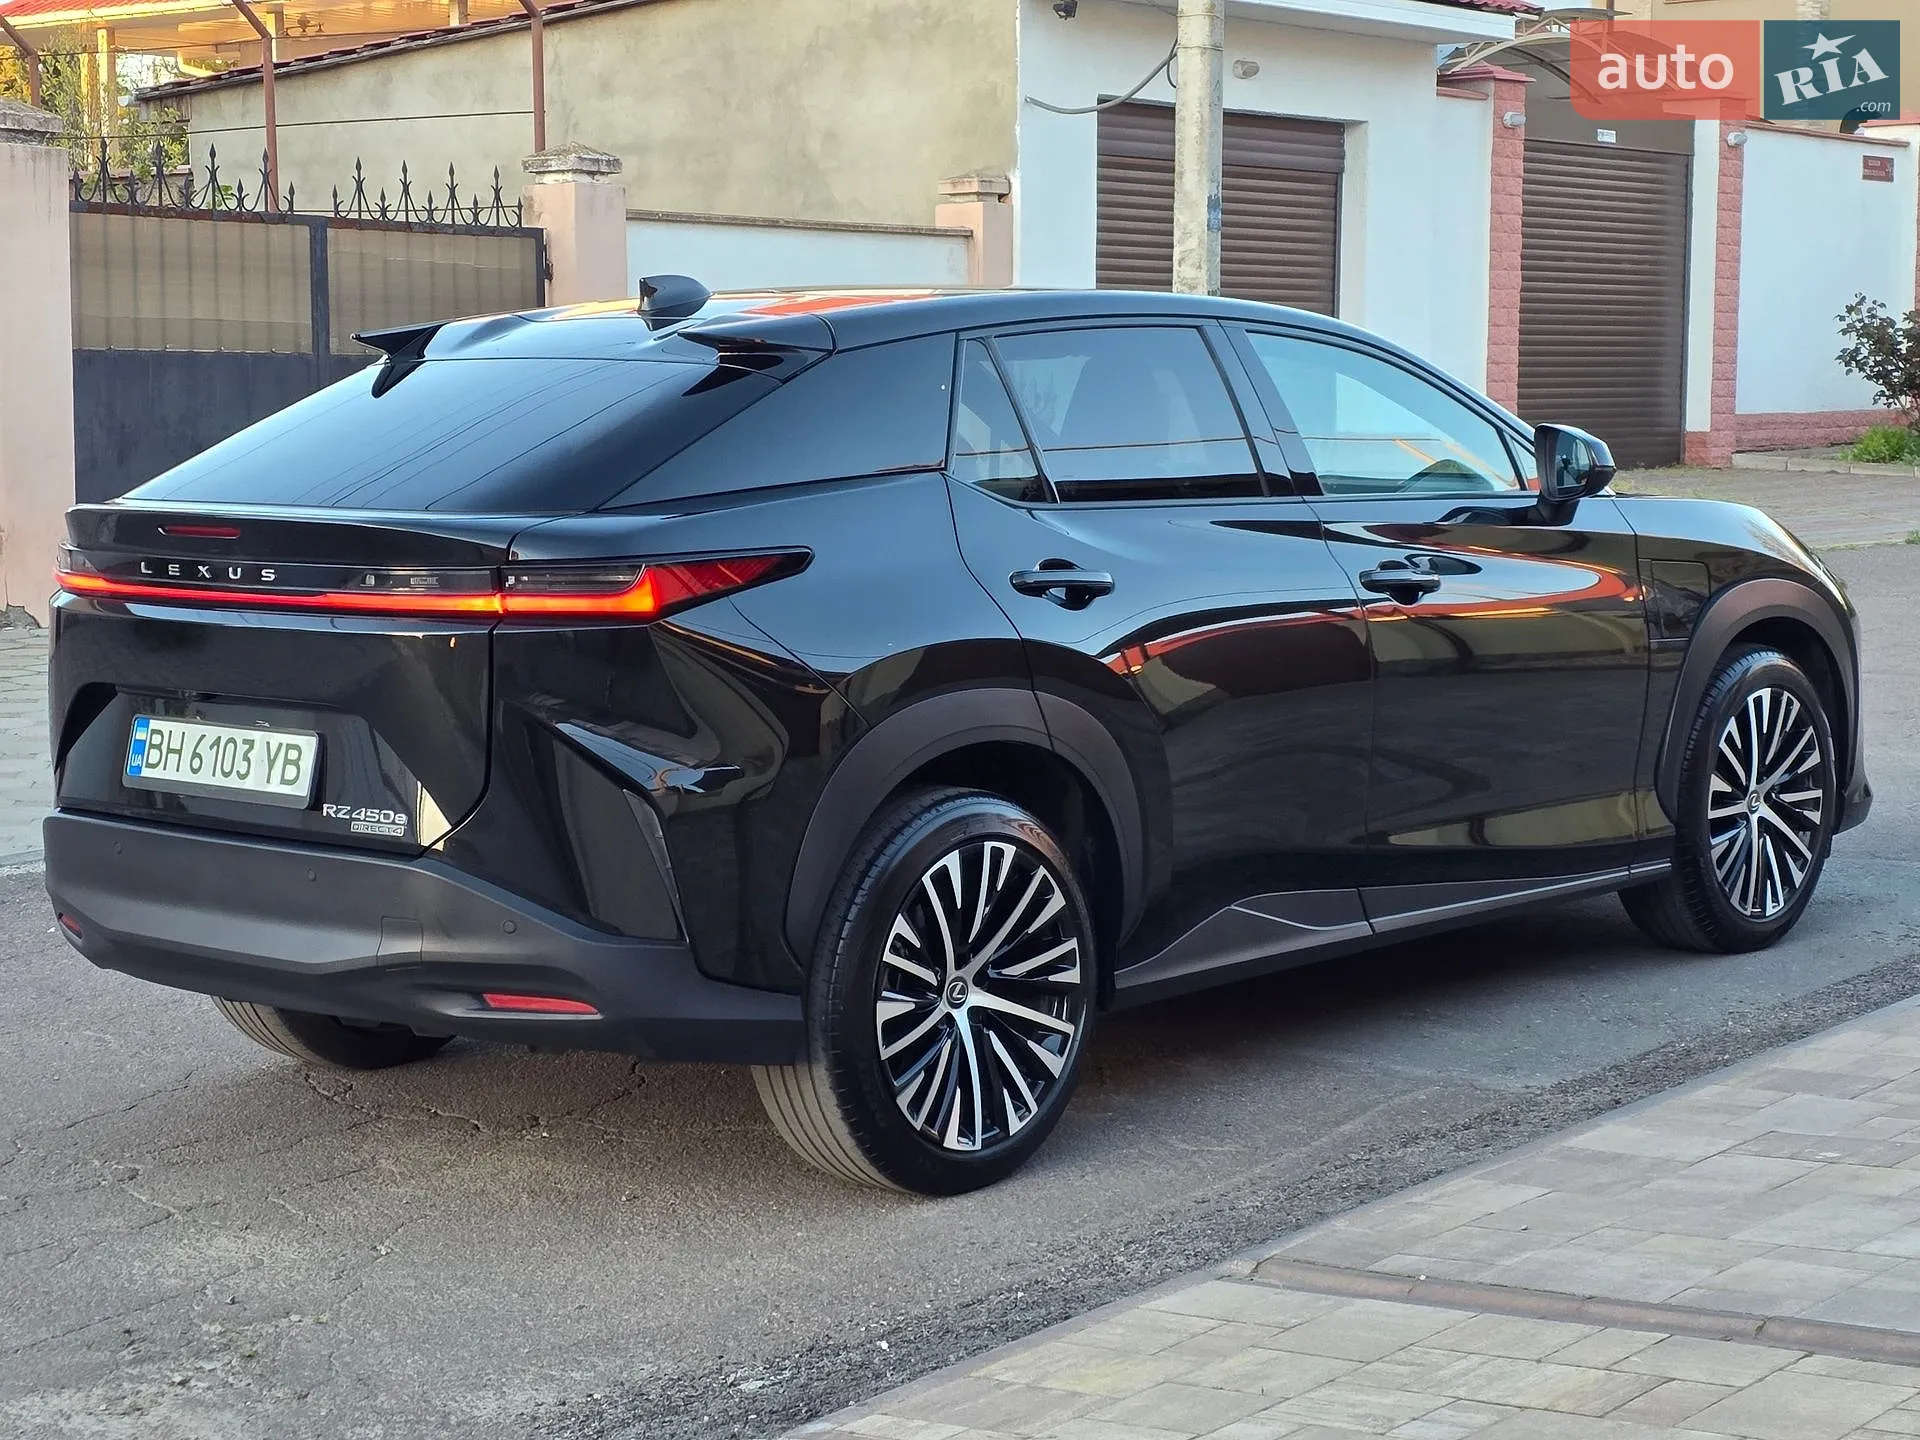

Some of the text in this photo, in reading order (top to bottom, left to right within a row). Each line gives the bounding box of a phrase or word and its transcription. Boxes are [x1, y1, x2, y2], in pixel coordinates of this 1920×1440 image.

[140, 561, 277, 581] LEXUS
[130, 755, 143, 767] UA
[145, 728, 303, 786] BH 6103 YB
